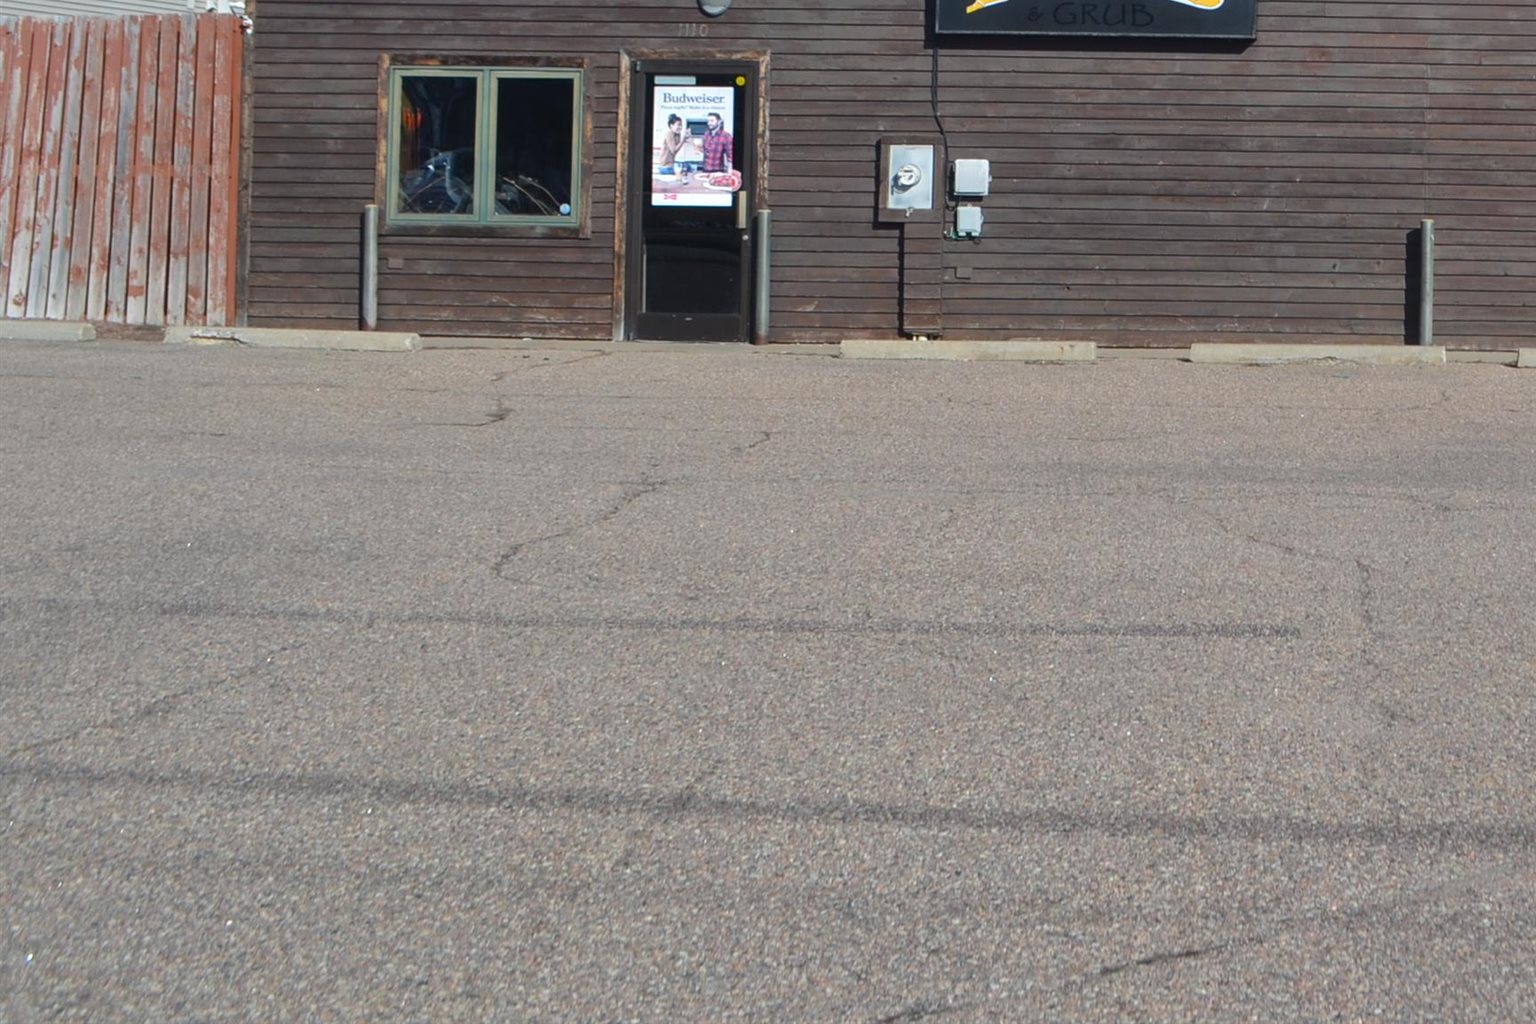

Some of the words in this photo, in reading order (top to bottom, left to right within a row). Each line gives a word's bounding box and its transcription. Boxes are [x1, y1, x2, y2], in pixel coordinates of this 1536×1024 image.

[1027, 5, 1045, 23] &
[1052, 1, 1155, 27] GRUB
[678, 23, 709, 37] 1110
[663, 92, 726, 104] Budweiser
